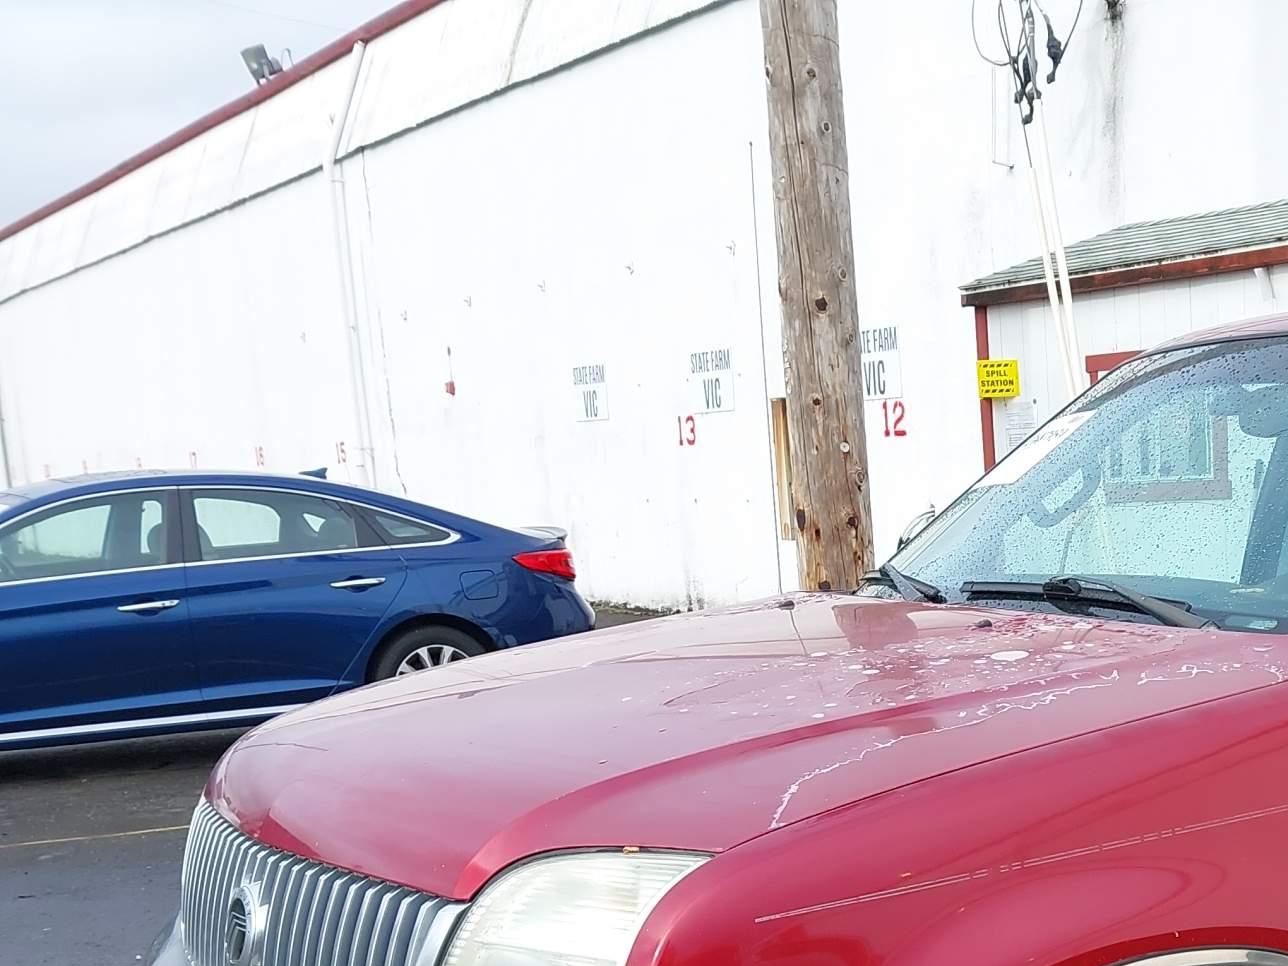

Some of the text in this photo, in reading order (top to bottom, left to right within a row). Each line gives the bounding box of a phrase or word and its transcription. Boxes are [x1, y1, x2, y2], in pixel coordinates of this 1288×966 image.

[873, 326, 898, 352] FARM
[690, 348, 731, 374] STATE FARM
[985, 369, 1009, 378] SPILL
[572, 364, 605, 386] STATE FARM
[863, 360, 886, 396] VIC
[980, 379, 1015, 387] STATION
[583, 389, 598, 418] VIC
[703, 377, 722, 409] VIC
[677, 415, 696, 446] 13
[882, 399, 907, 437] 12
[335, 441, 347, 464] 15
